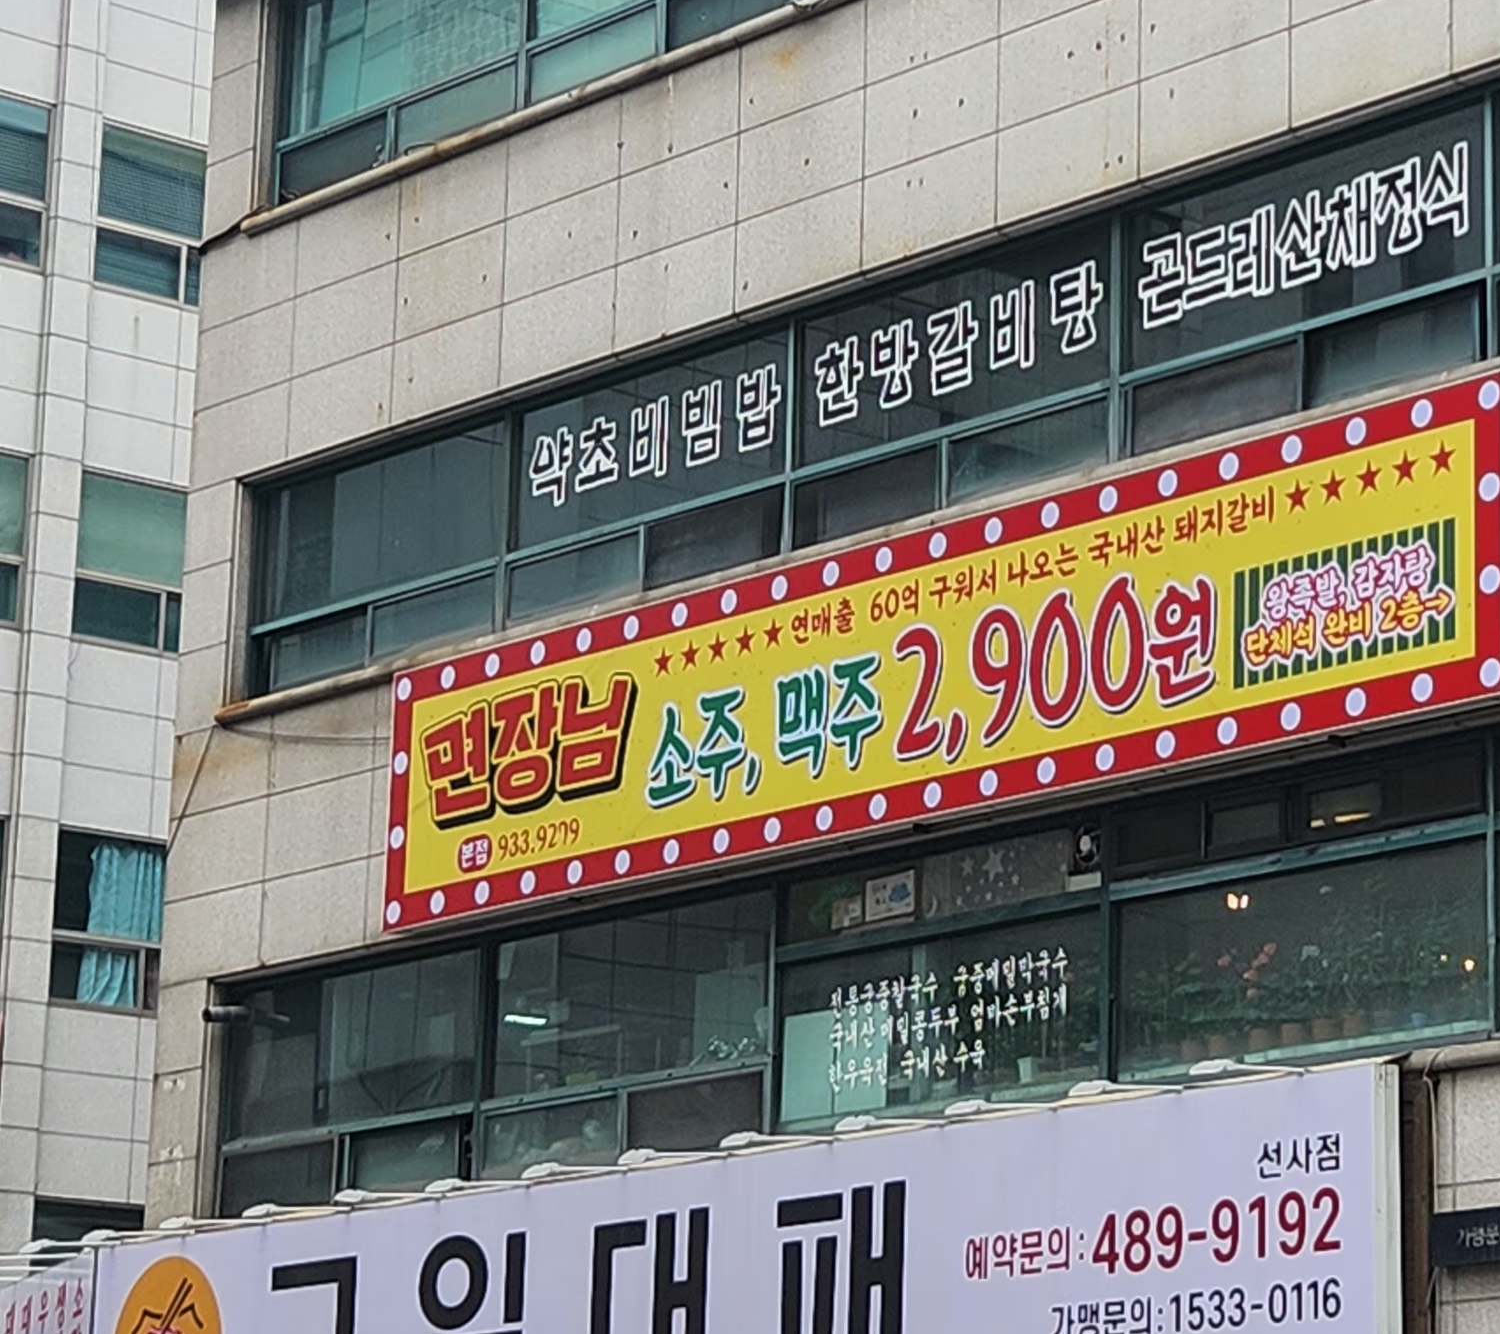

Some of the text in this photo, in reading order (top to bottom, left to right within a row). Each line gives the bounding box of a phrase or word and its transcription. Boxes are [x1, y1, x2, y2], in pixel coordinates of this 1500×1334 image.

[529, 364, 781, 507] 약초비빔밥
[814, 263, 1103, 427] 한방갈비탕
[1136, 143, 1473, 331] 곤드레산채정식
[789, 485, 1277, 644] 연매출 60억 구워서 나오는 국내산 돼지갈비
[645, 572, 1217, 810] 소주, 맥주 2,900원
[1244, 615, 1316, 667] 단체석
[1322, 599, 1372, 647] 완비
[422, 672, 636, 827] 면장님
[459, 818, 581, 869] 본점 933.9279
[1257, 1132, 1342, 1179] 선사점
[1091, 1186, 1342, 1275] 489-9192
